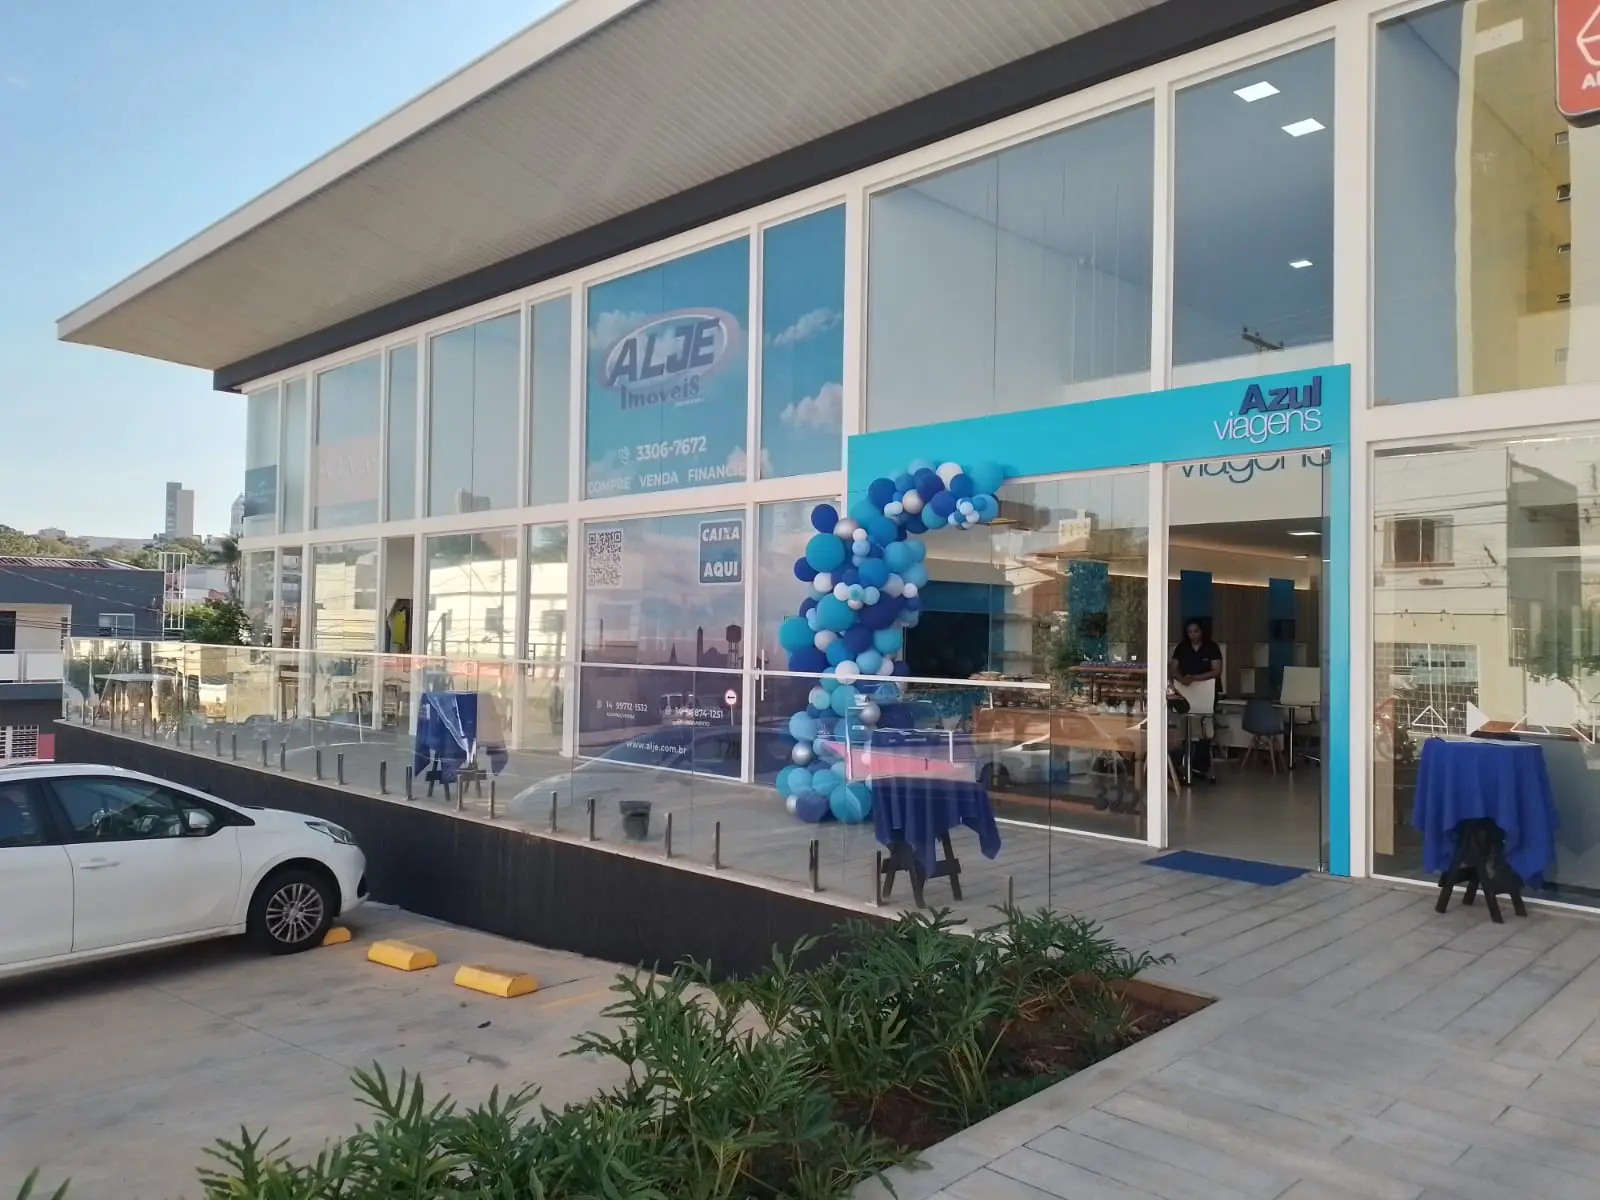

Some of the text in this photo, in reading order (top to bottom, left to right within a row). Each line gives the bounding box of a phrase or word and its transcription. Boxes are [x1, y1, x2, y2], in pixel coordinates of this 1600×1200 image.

[608, 317, 720, 387] ALJE
[1239, 375, 1322, 416] Azul
[1213, 408, 1322, 444] viagens
[636, 436, 707, 462] 3306-7672
[639, 470, 679, 488] VENDA
[702, 526, 740, 542] CAIXA
[703, 561, 738, 577] AQUI
[626, 740, 688, 755] www.alje.com.br
